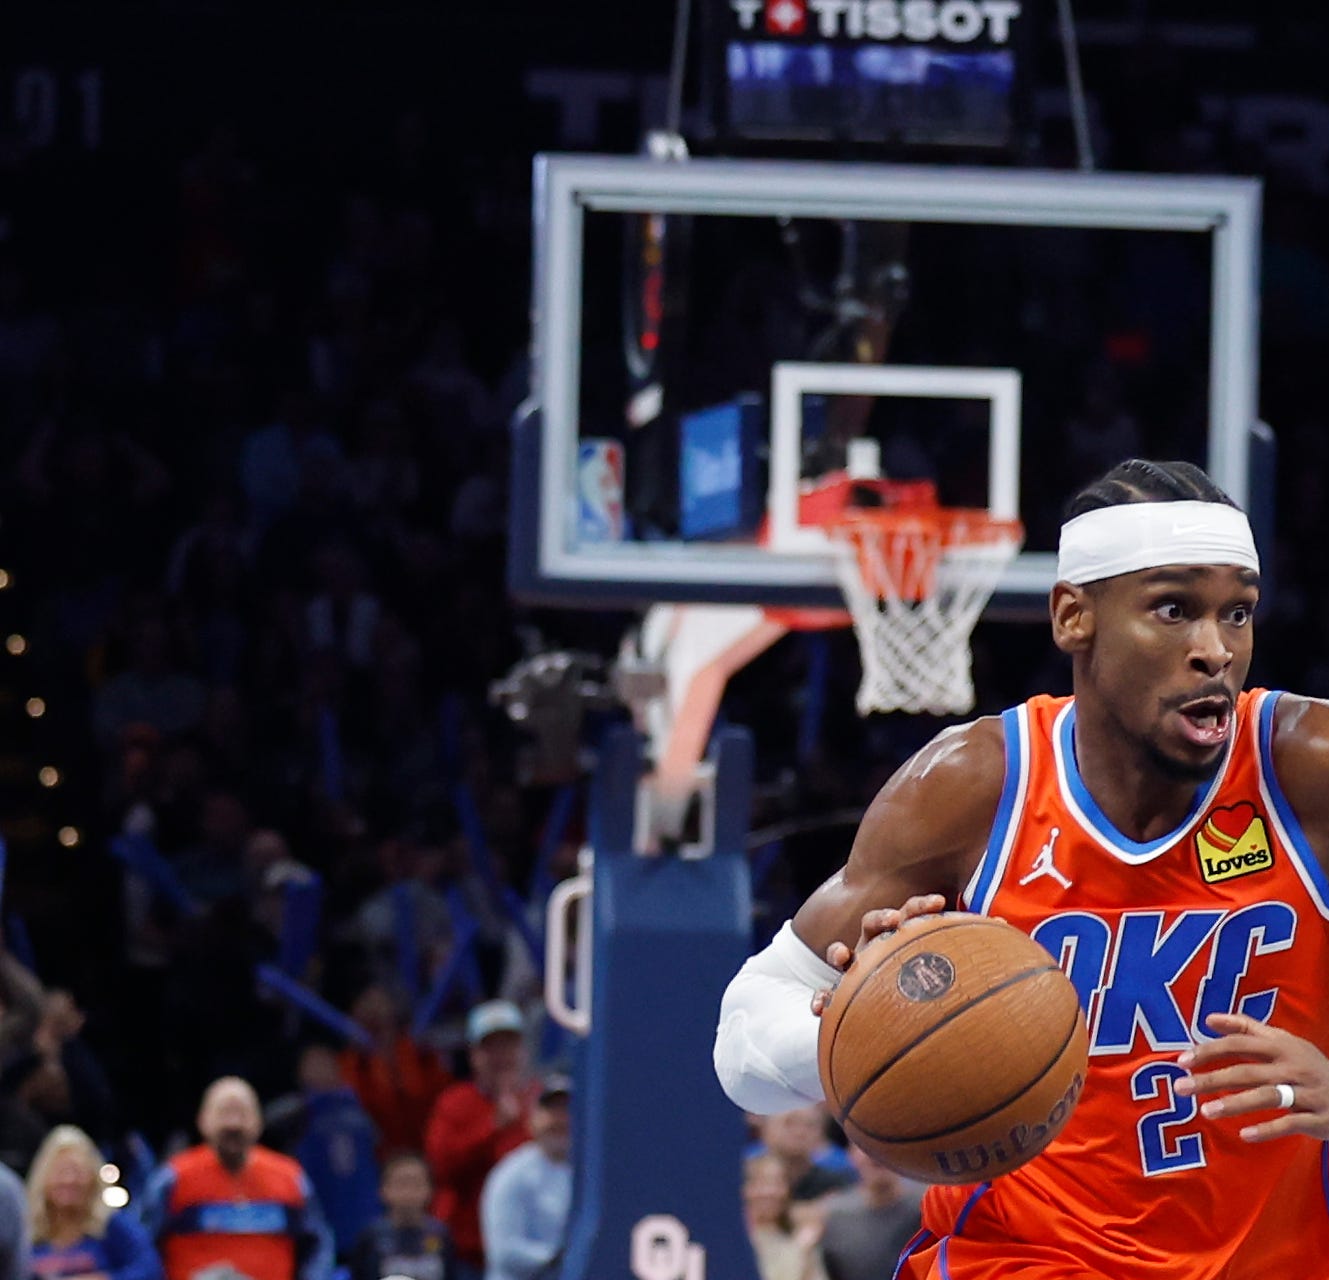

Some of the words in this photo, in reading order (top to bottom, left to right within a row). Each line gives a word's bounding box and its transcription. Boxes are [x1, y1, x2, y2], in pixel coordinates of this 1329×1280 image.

[809, 0, 1021, 43] TISSOT
[1029, 900, 1298, 1057] OKC
[931, 1072, 1085, 1177] Wilson
[1130, 1060, 1207, 1178] 2
